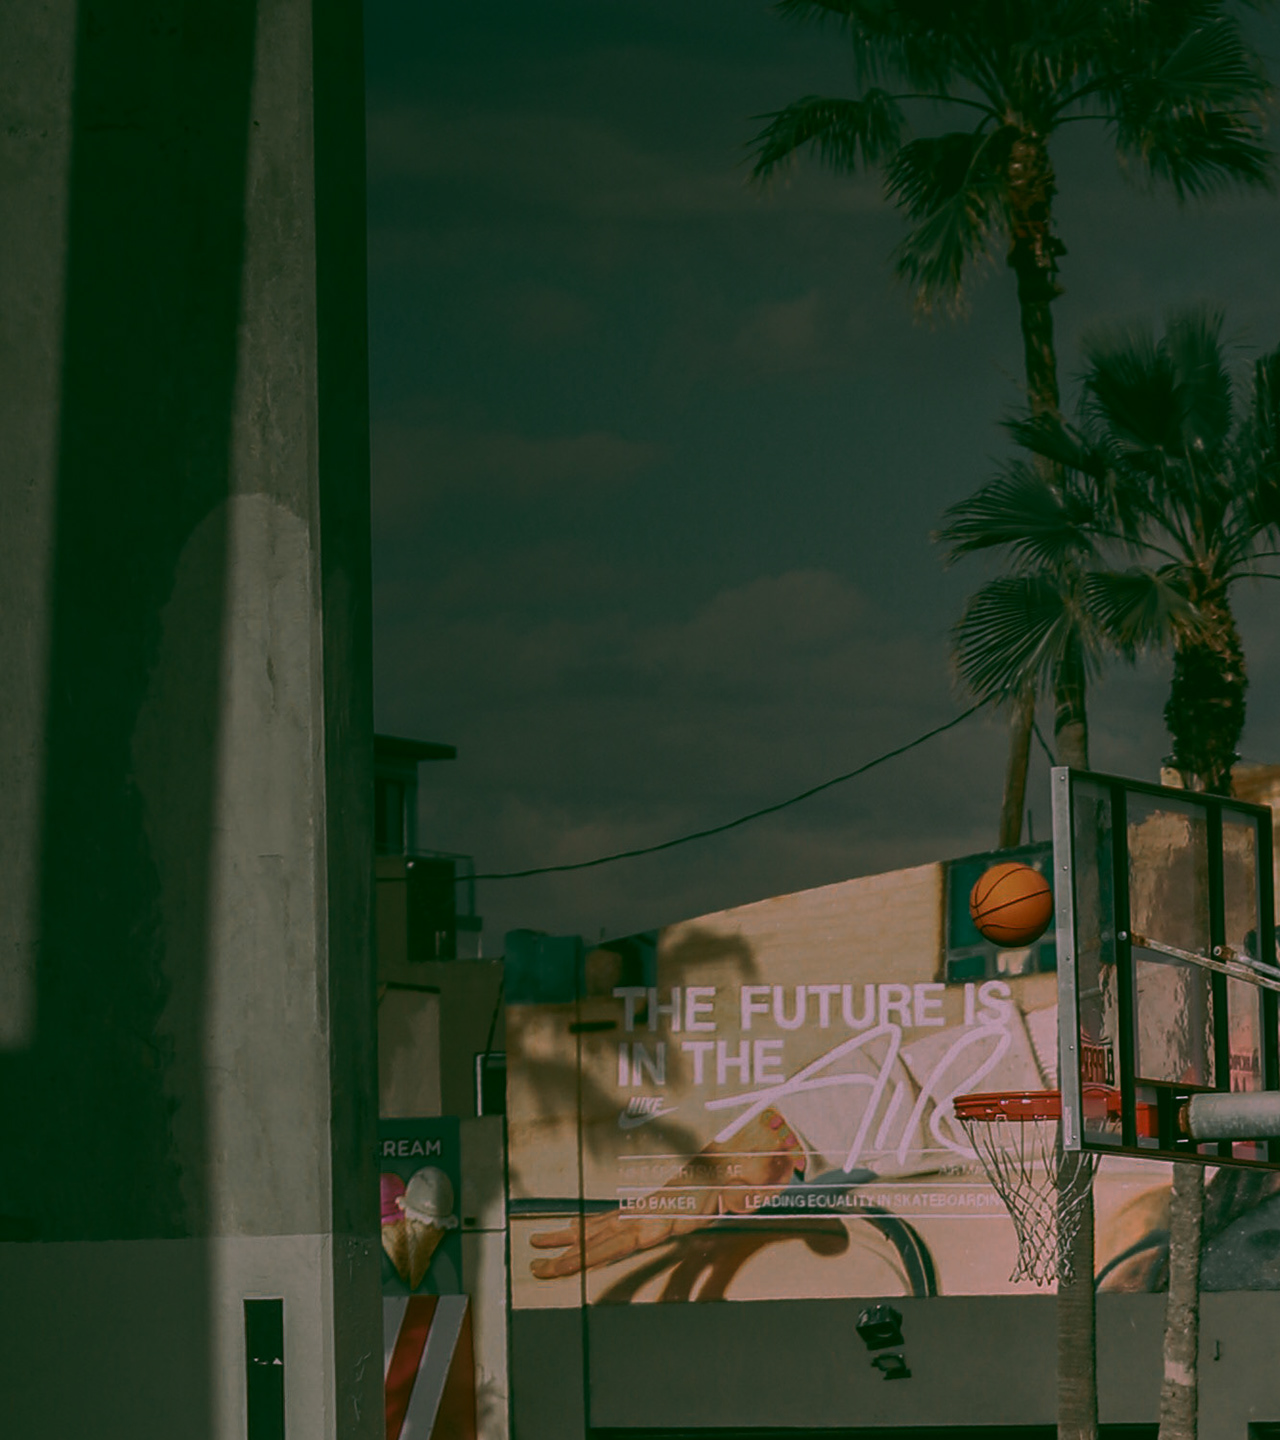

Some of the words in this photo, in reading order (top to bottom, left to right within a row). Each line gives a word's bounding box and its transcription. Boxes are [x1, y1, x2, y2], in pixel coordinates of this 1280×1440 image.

[613, 985, 717, 1033] THE
[741, 982, 947, 1031] FUTURE
[964, 979, 1012, 1028] IS
[617, 1041, 667, 1088] IN
[681, 1038, 787, 1086] THE
[627, 1095, 665, 1114] NIKE
[381, 1139, 442, 1158] REAM
[618, 1195, 647, 1211] LEO
[648, 1194, 698, 1211] BAKER
[744, 1193, 807, 1209] LEADING
[807, 1193, 876, 1209] EQUALITY
[876, 1193, 891, 1208] IN
[894, 1192, 1003, 1209] SKATEBOARDIN
